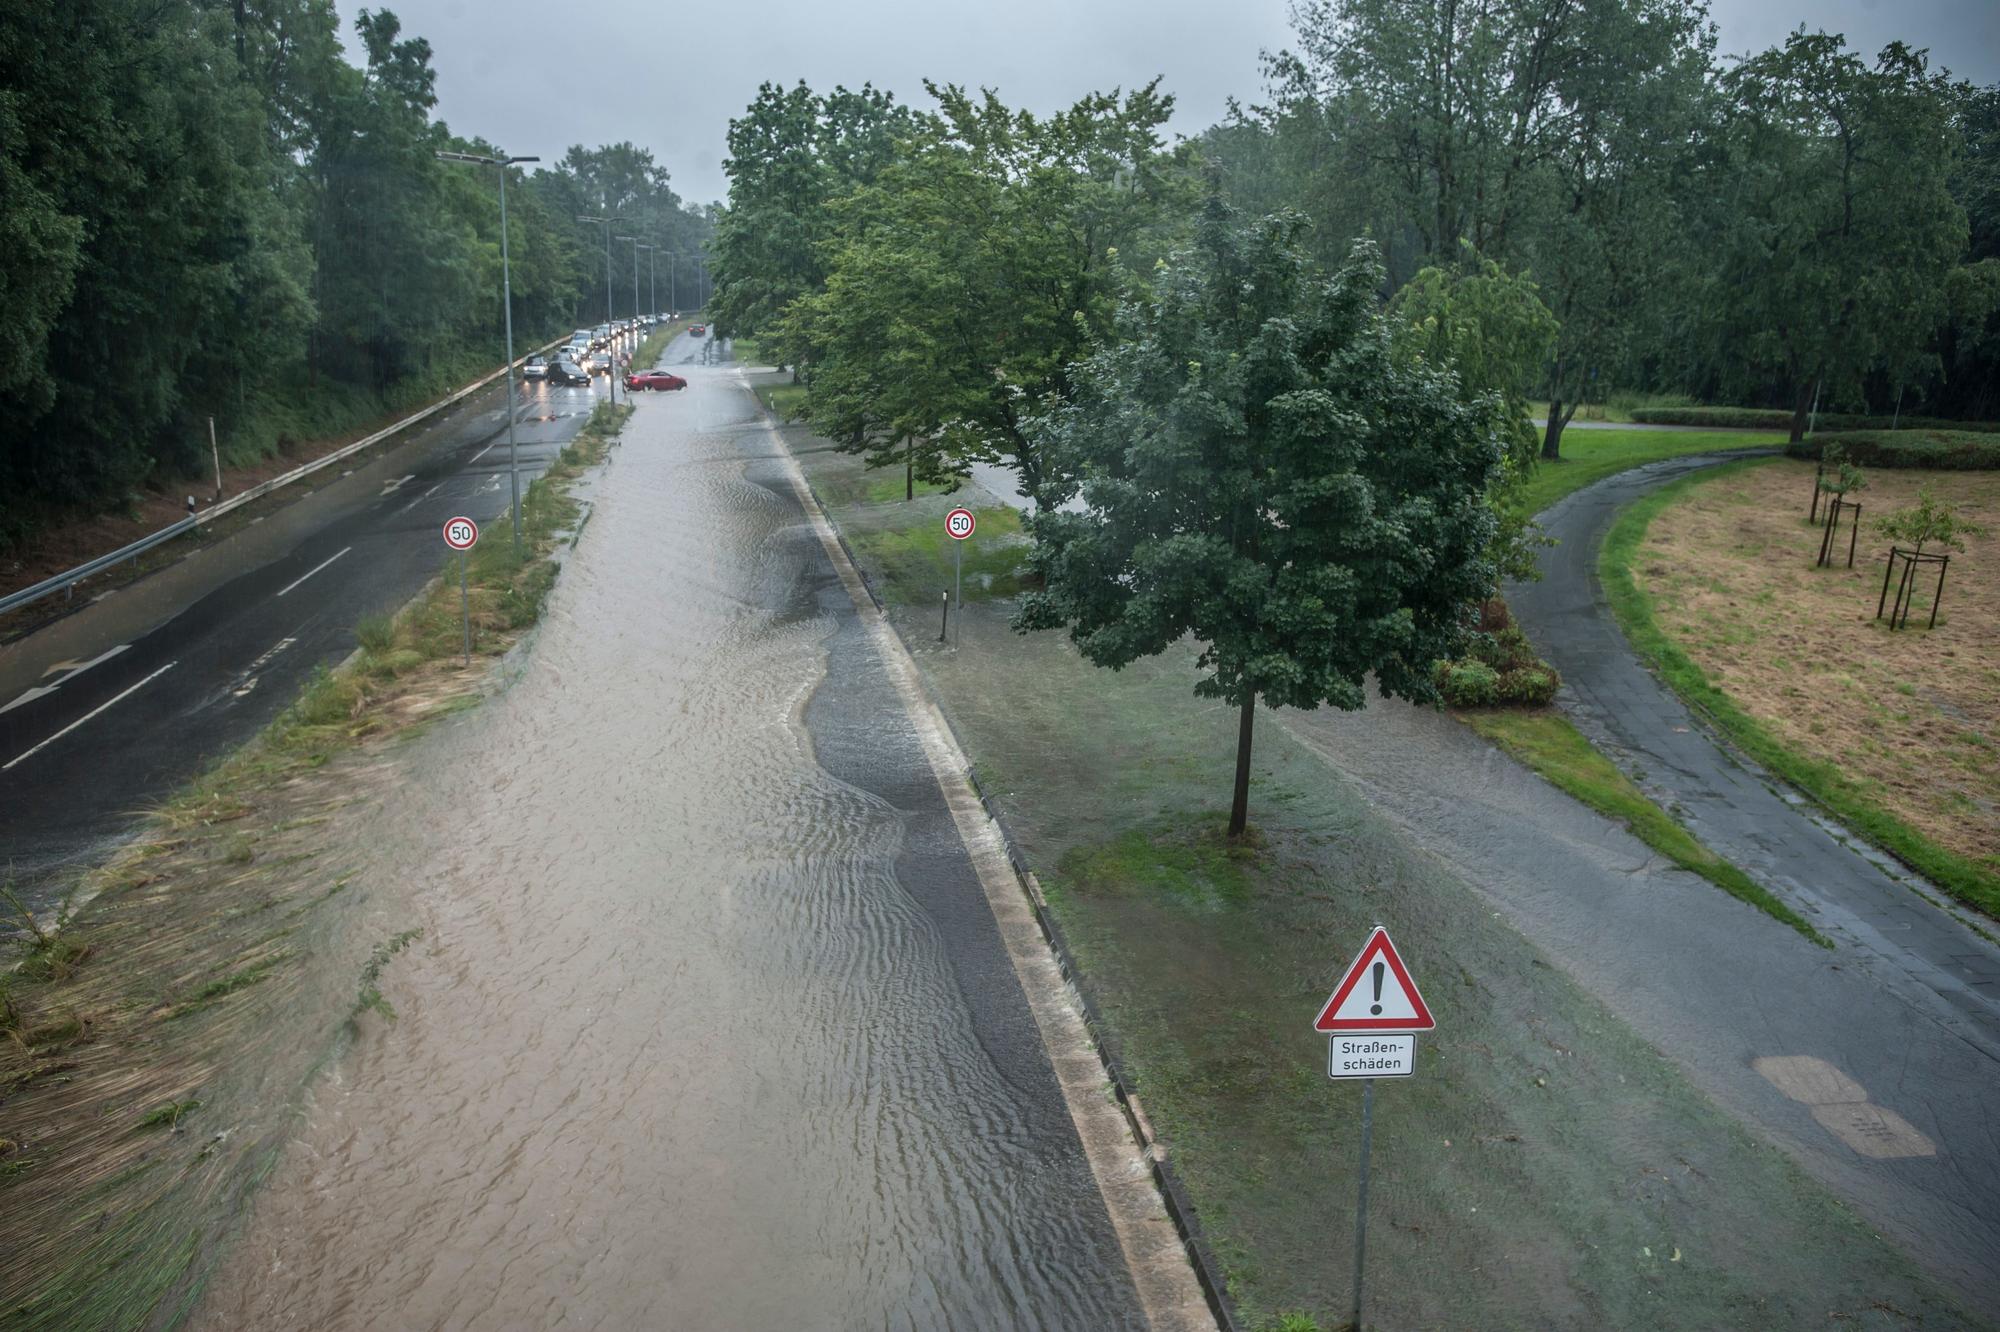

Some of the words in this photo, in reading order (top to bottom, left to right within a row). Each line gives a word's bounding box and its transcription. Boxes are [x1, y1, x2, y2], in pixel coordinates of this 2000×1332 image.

[952, 517, 969, 531] 50
[452, 526, 471, 540] 50
[1342, 1041, 1404, 1054] Straßen-
[1343, 1057, 1401, 1070] schäden
